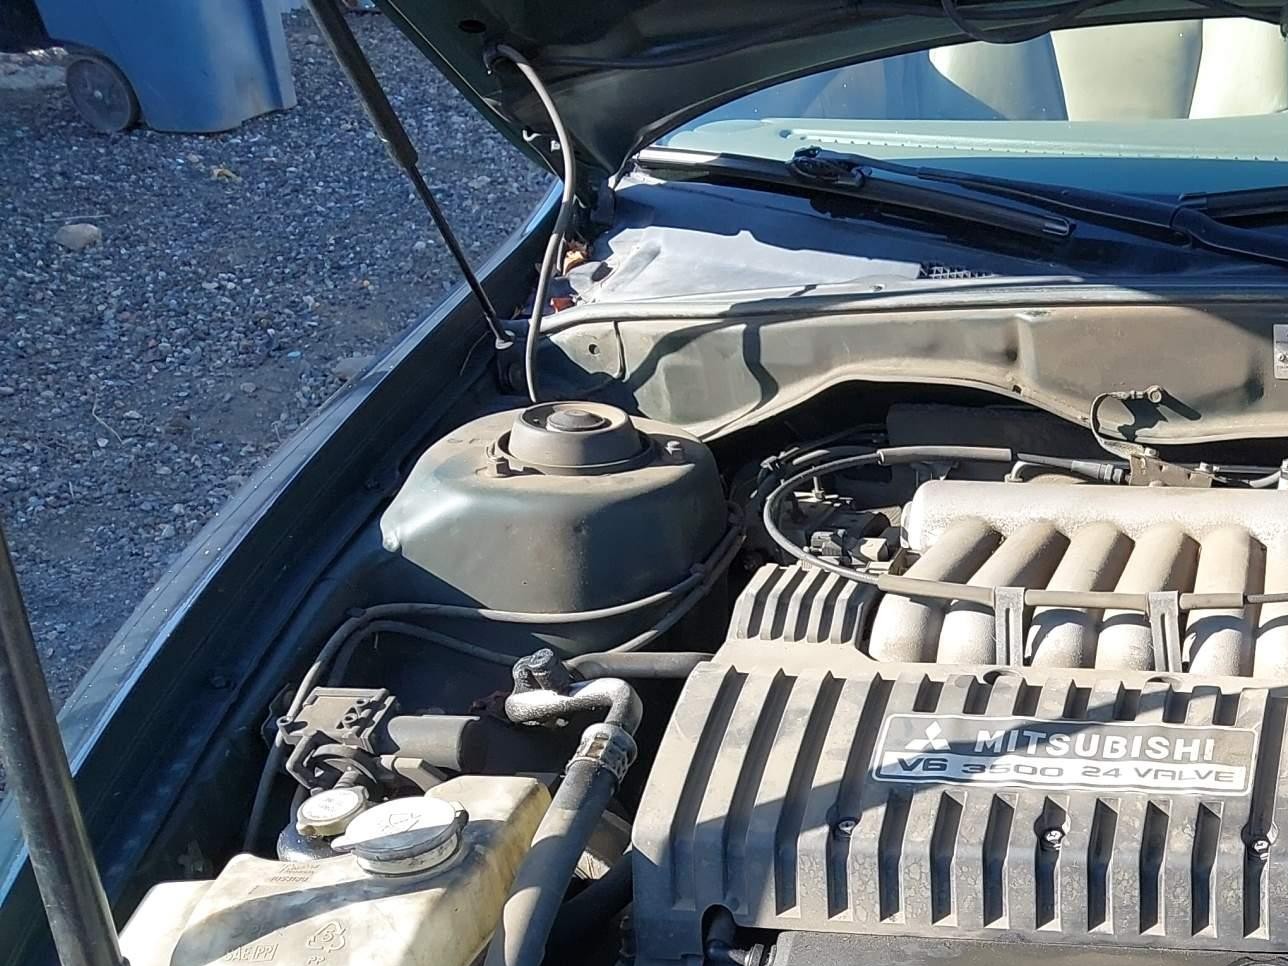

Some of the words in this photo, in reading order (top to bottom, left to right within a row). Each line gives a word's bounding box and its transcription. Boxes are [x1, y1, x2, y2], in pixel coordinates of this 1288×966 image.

[974, 728, 1216, 760] MITSUBISHI
[897, 756, 949, 772] V6
[960, 762, 1064, 778] 3500
[1081, 767, 1121, 779] 24
[1134, 767, 1237, 782] VALVE
